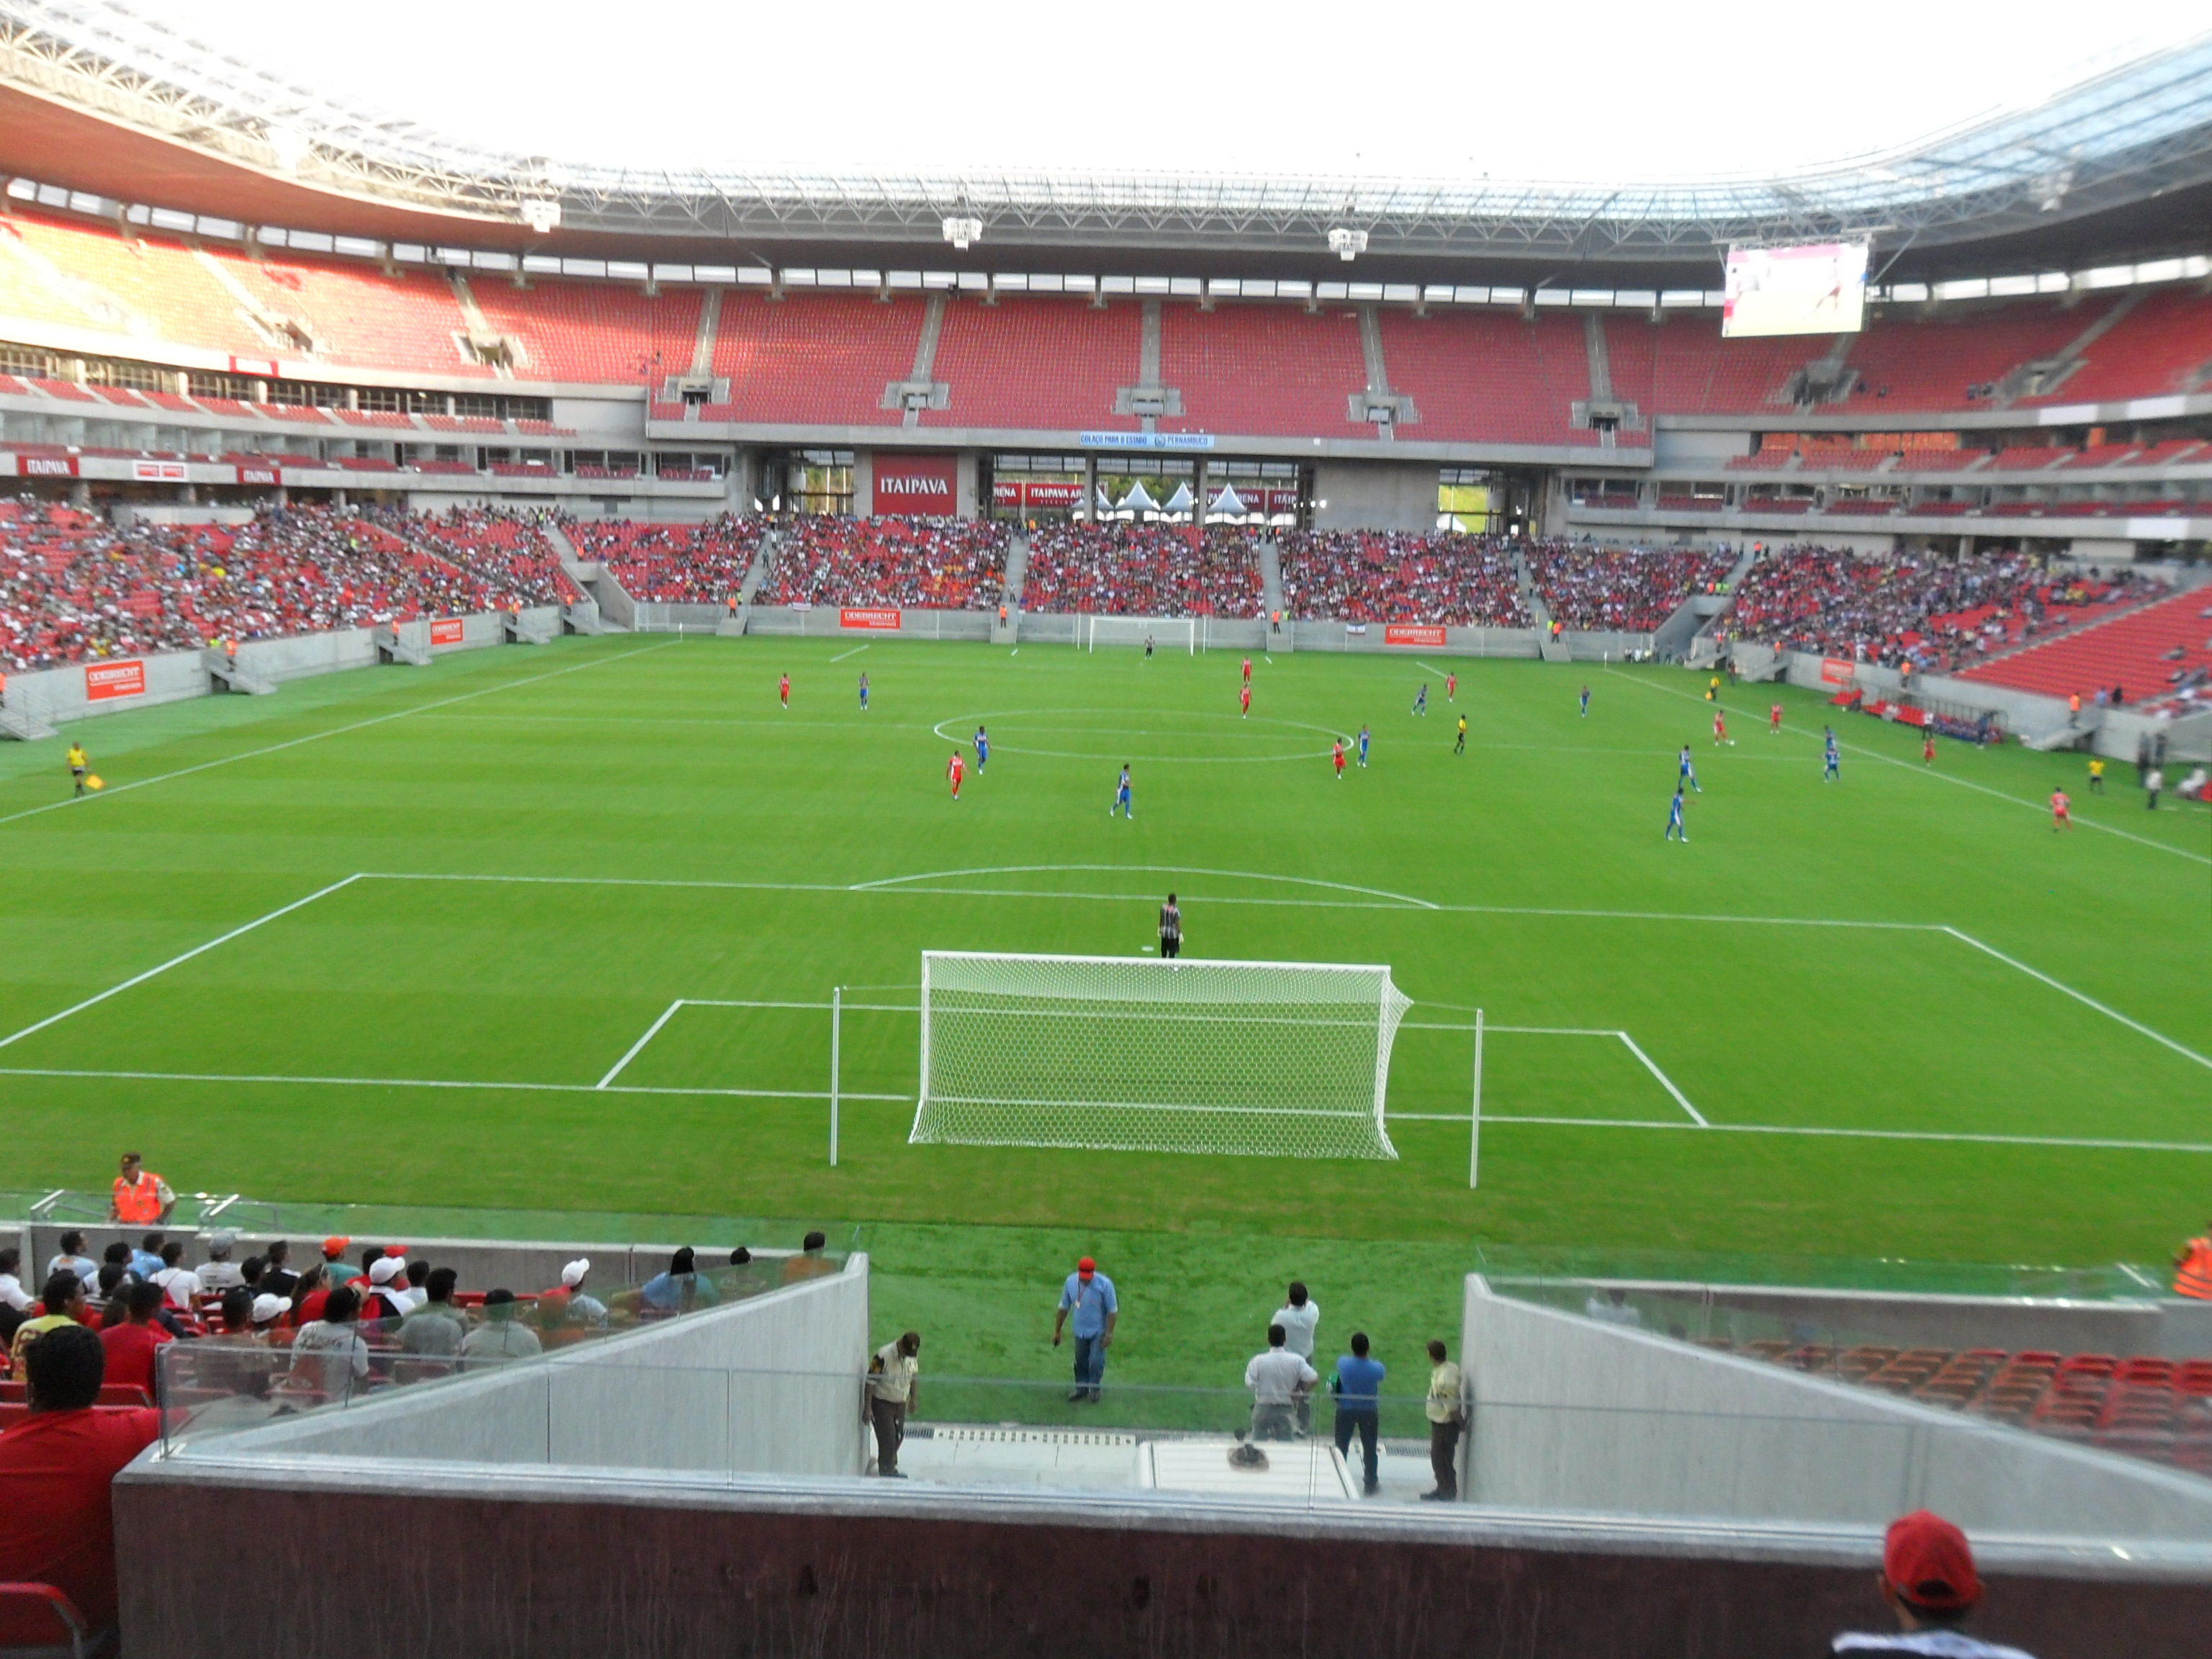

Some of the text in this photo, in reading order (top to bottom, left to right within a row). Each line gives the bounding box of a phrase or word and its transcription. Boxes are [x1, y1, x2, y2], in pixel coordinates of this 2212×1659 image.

[1167, 436, 1208, 446] PERNAMBUCO
[27, 459, 71, 475] ITAIPAVA
[881, 477, 948, 494] ITAIPAVA
[994, 487, 1016, 497] RENA
[1031, 487, 1069, 498] ITAIPAVA
[1236, 493, 1259, 503] RENA
[845, 611, 896, 620] ODEBRECHT
